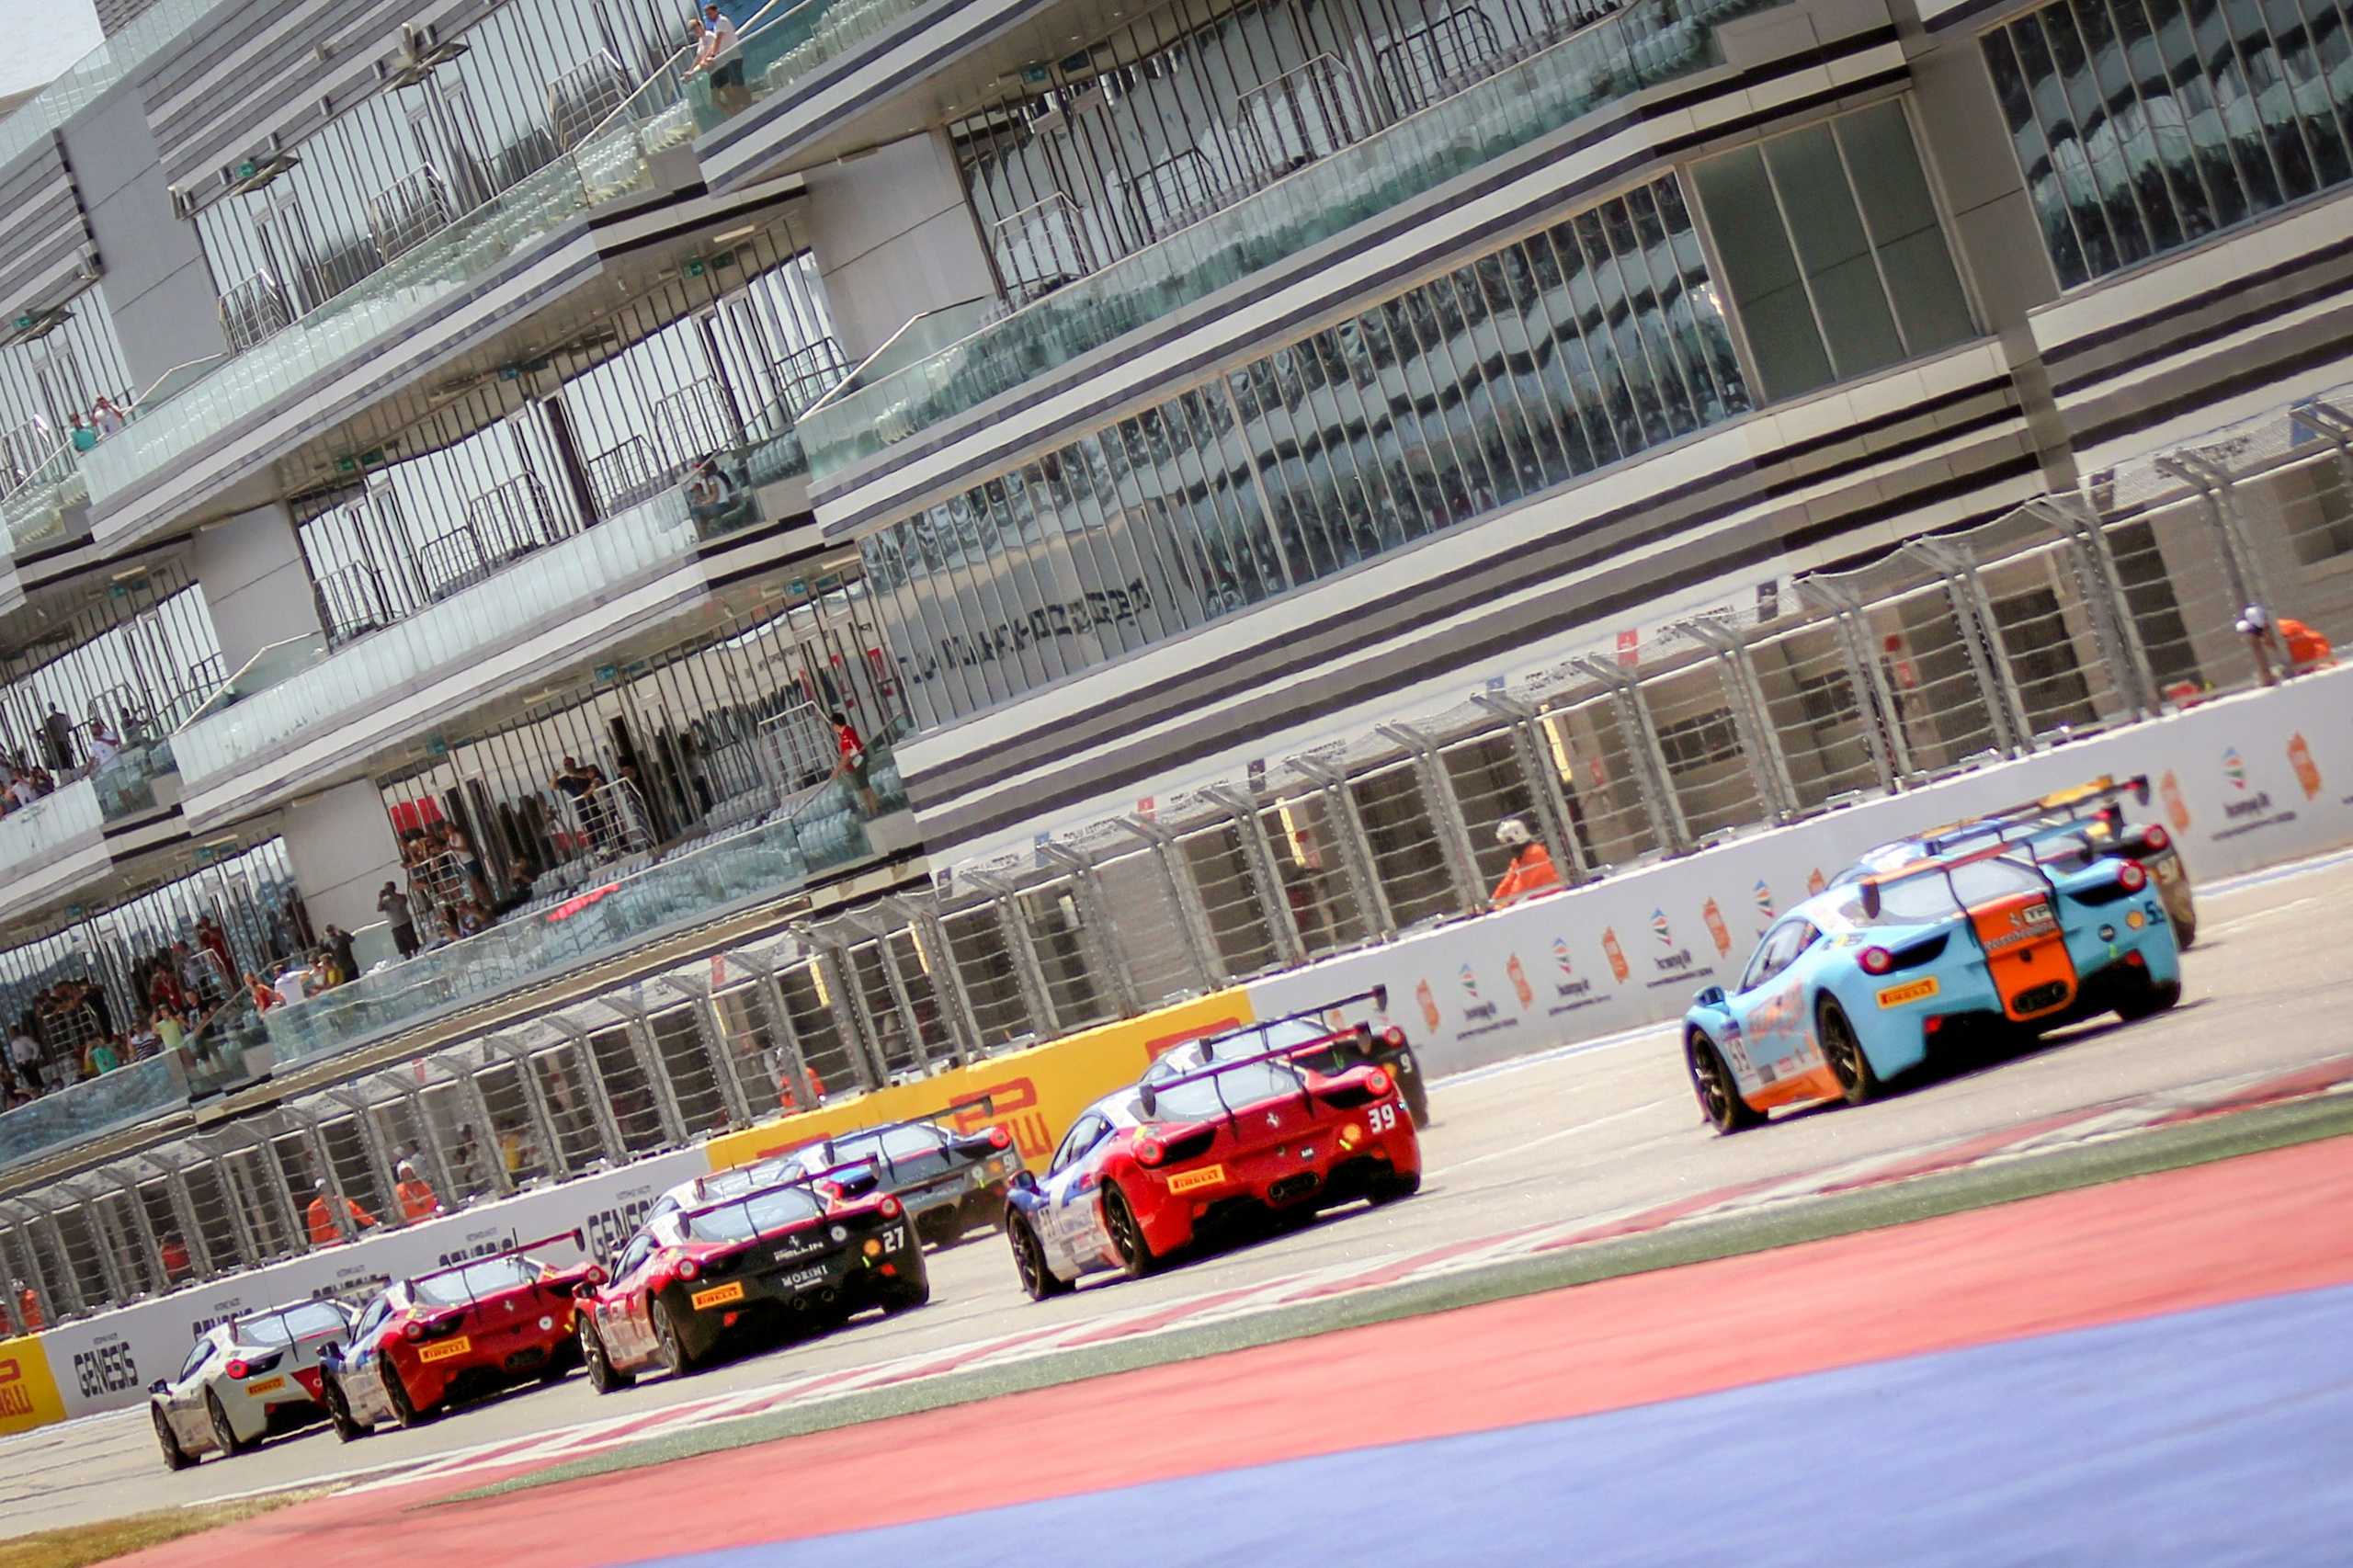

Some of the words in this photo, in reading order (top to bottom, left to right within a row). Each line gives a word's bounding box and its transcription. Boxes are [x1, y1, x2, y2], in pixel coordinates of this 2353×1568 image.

[1368, 1103, 1396, 1135] 39
[882, 1226, 904, 1254] 27
[782, 1265, 828, 1287] MORINI
[74, 1341, 138, 1398] GENESIS
